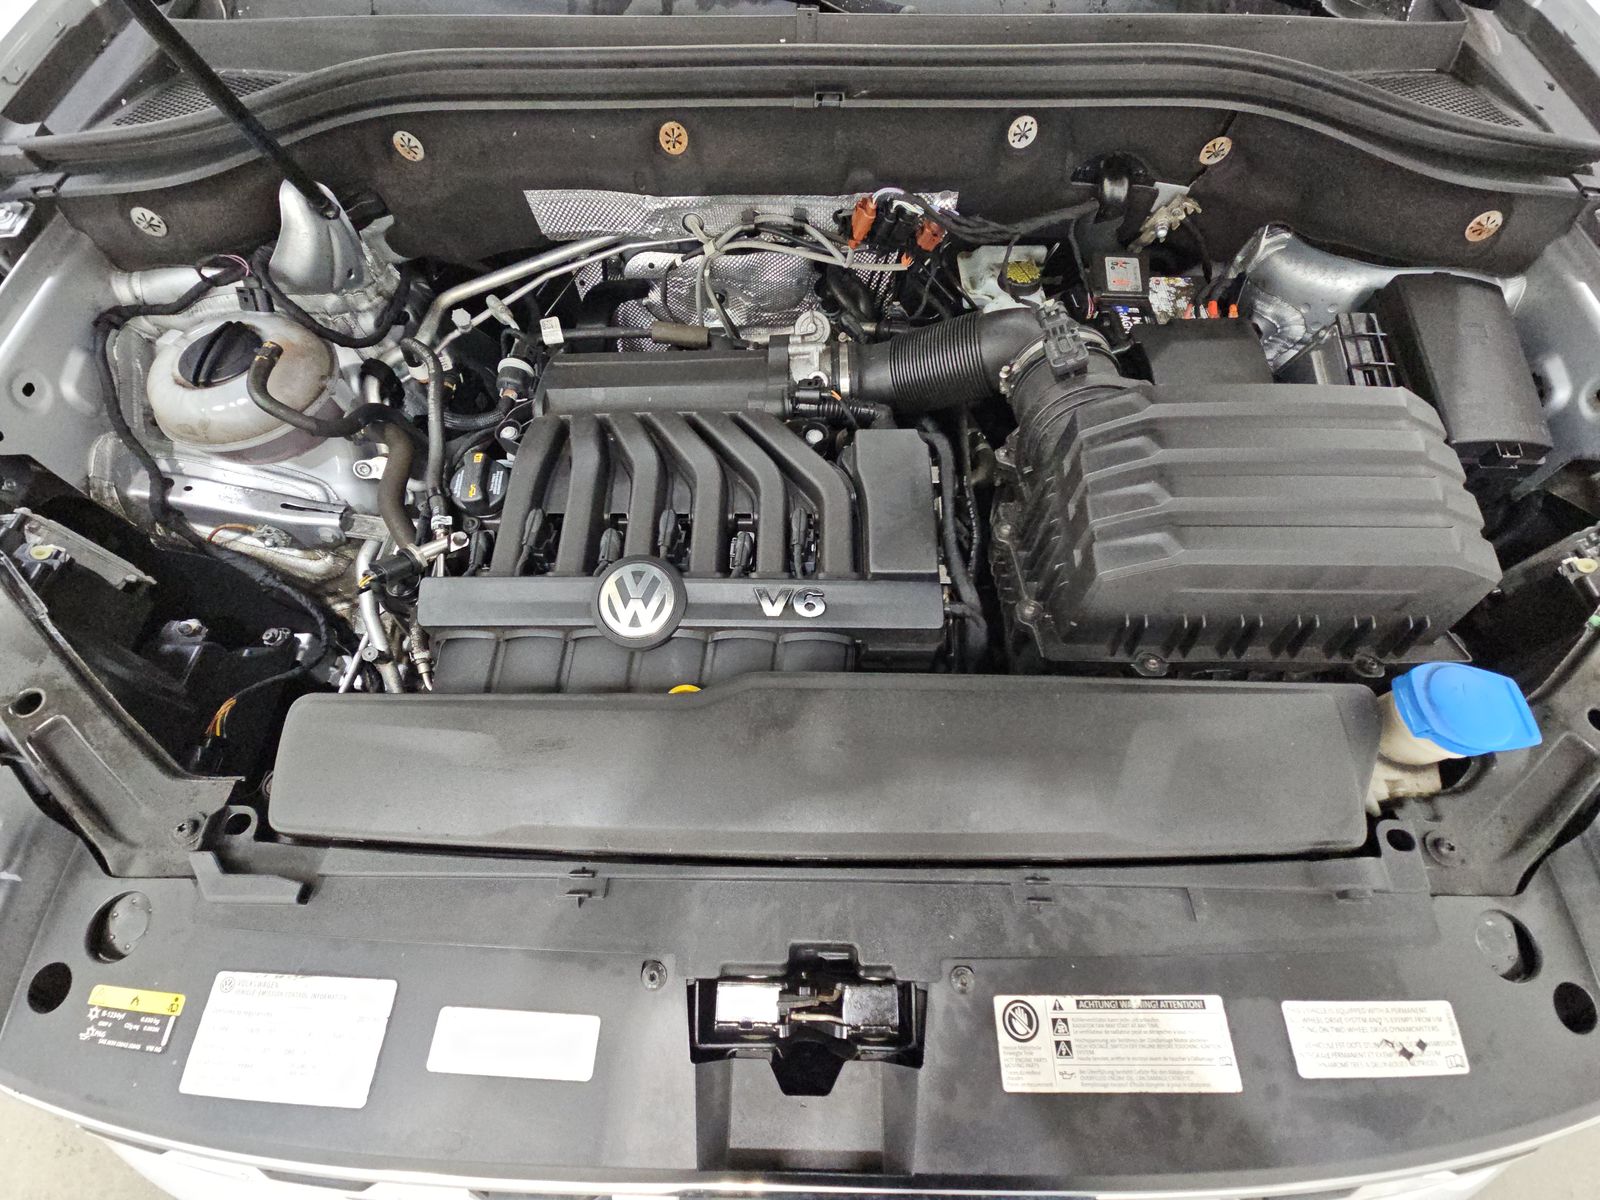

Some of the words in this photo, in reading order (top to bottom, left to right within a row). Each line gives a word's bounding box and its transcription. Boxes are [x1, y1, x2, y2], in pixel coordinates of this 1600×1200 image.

[753, 587, 826, 618] V6
[1079, 1000, 1119, 1010] ACHTUNG!
[1119, 1000, 1159, 1010] WANING!
[1160, 1000, 1204, 1010] ATTENTION!
